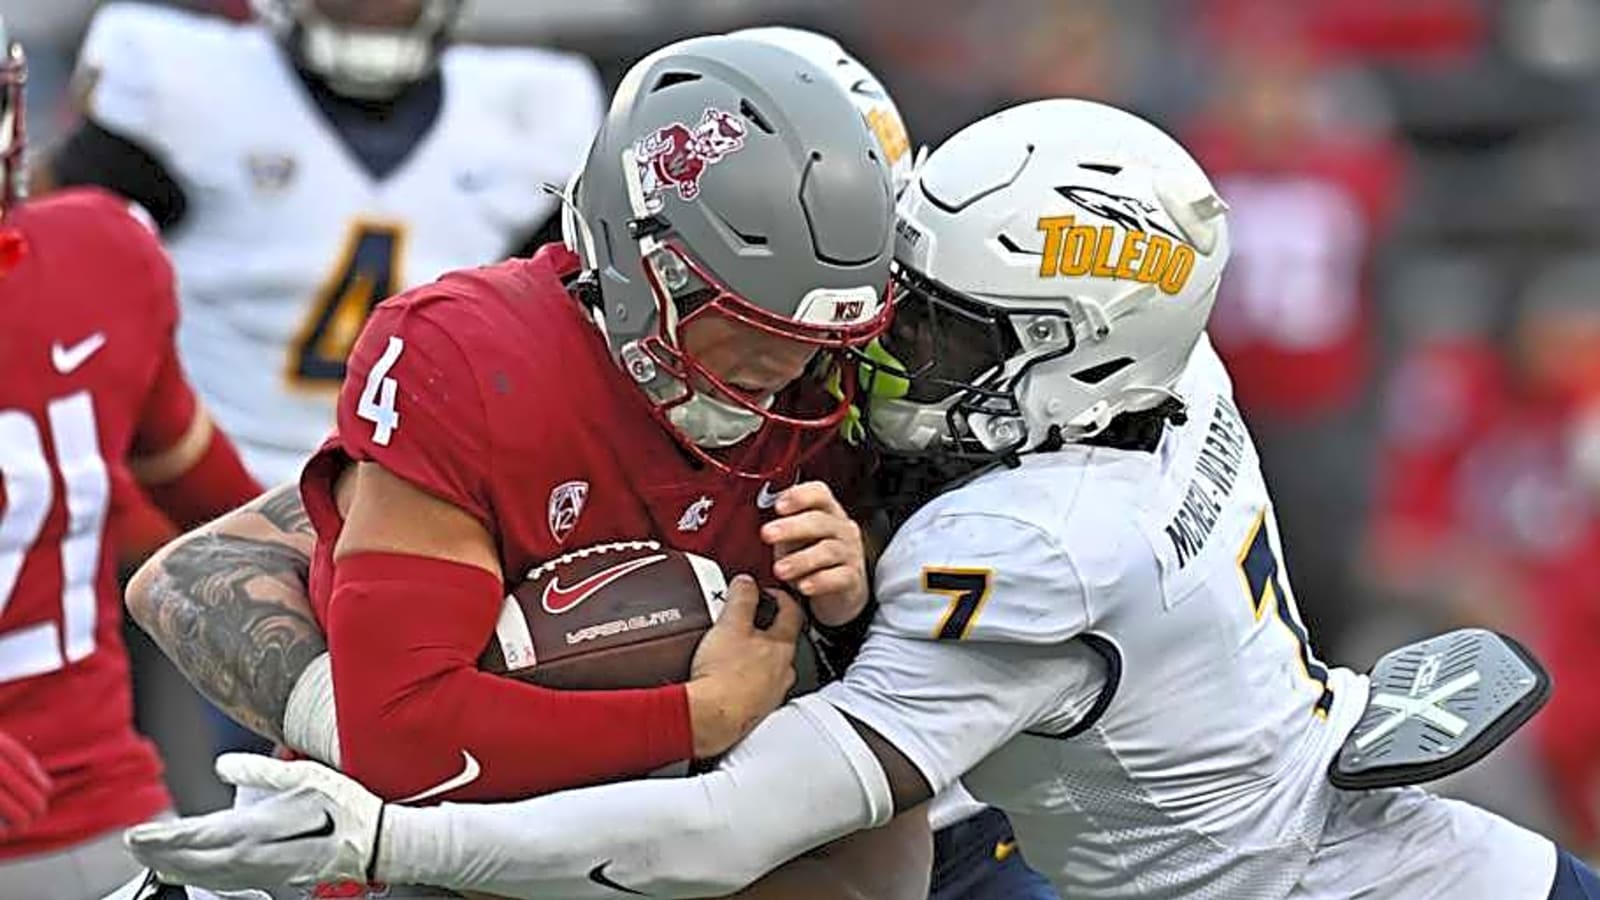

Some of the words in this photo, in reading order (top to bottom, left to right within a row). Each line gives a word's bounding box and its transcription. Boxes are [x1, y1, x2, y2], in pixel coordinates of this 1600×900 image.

[1037, 215, 1195, 295] TOLEDO
[832, 301, 865, 321] WSU
[357, 336, 404, 446] 4
[920, 566, 994, 640] 7
